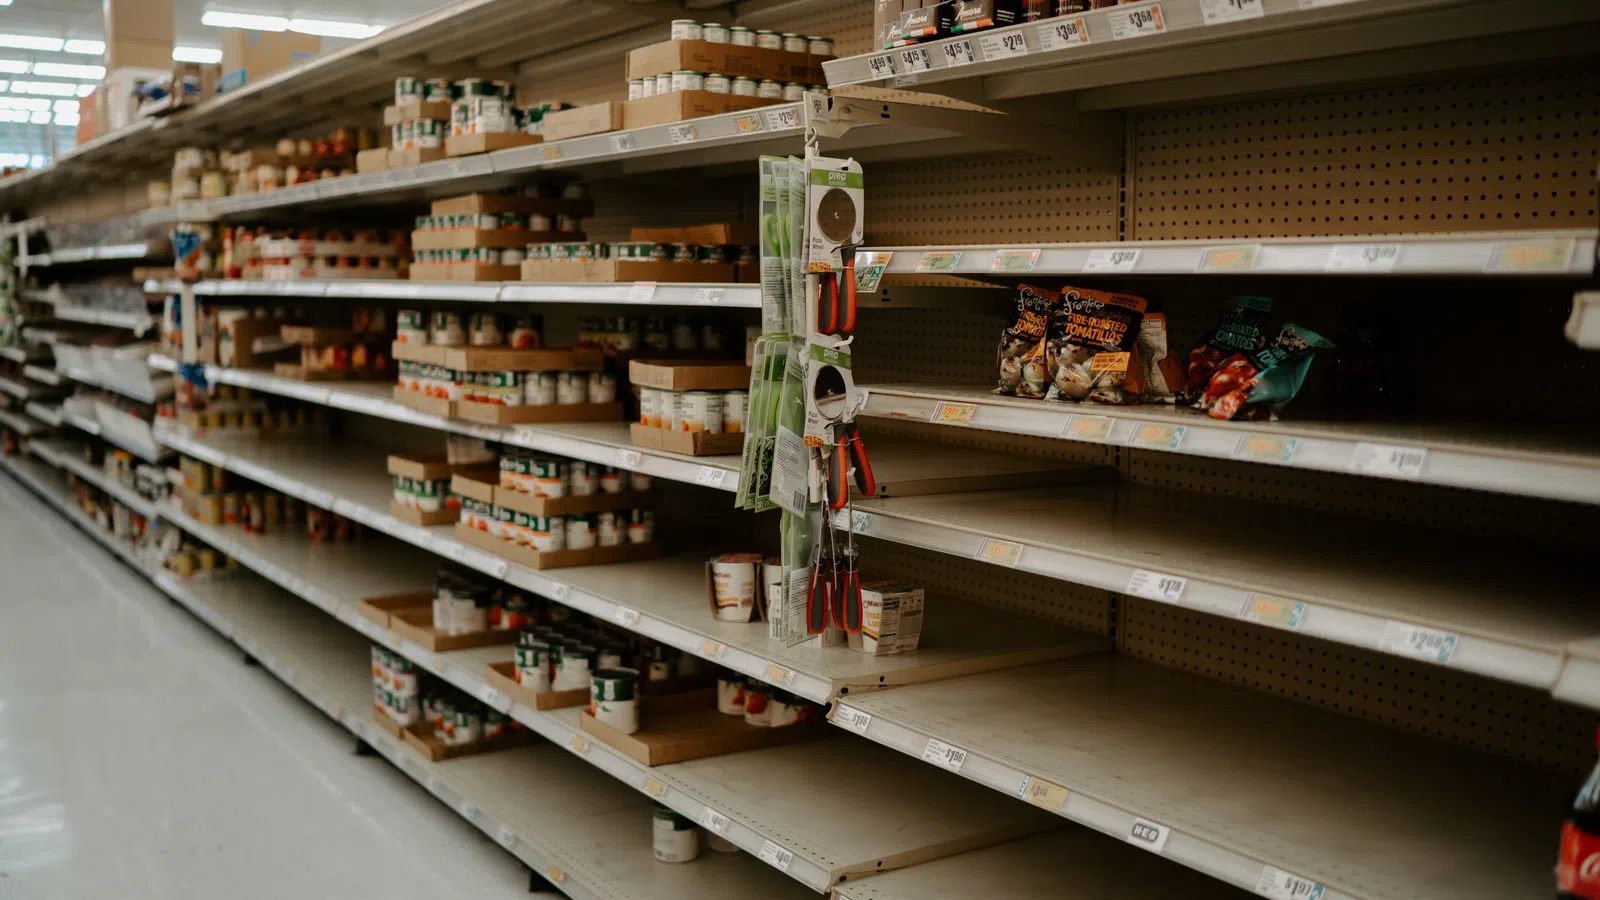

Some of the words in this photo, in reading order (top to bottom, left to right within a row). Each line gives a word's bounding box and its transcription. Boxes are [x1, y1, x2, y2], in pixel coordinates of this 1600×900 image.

[1056, 23, 1077, 40] $368
[944, 42, 963, 59] $415
[1003, 34, 1023, 51] $279
[902, 50, 920, 65] $415
[828, 171, 847, 182] prep
[1067, 313, 1128, 333] FIRE-ROASTED
[823, 348, 840, 359] prep
[945, 748, 965, 763] $196
